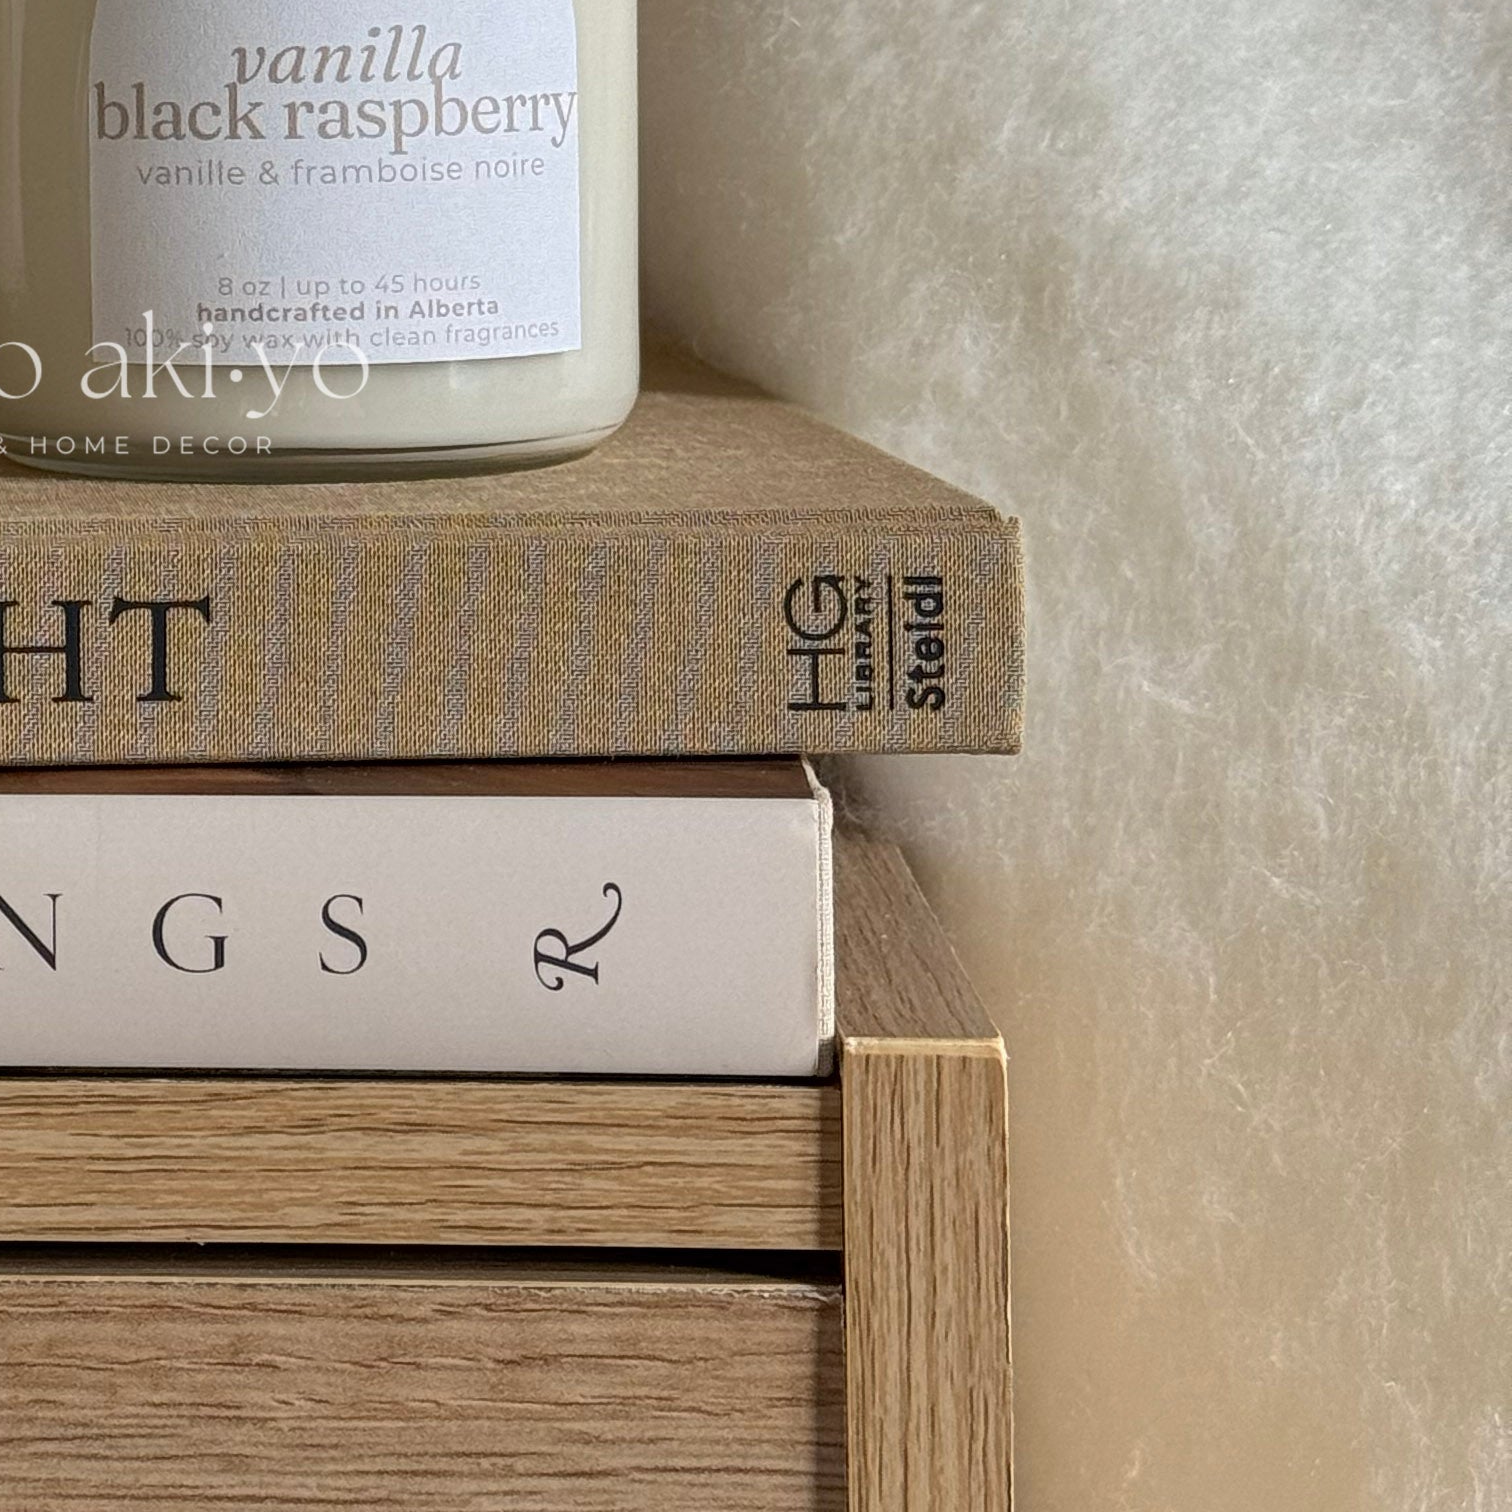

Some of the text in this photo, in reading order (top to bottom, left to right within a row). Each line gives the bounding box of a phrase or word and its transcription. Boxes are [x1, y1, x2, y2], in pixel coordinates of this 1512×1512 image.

[231, 24, 463, 85] vanilla
[94, 79, 578, 154] black raspberry
[136, 153, 545, 186] vanille & framboise noire
[196, 298, 499, 322] handcrafted in Alberta
[218, 277, 232, 296] 8
[242, 280, 270, 296] oz
[296, 278, 330, 299] up
[339, 277, 365, 295] to
[374, 274, 404, 294] 45
[413, 273, 480, 292] hours
[192, 333, 234, 354] soy
[242, 334, 294, 349] wax
[302, 327, 360, 348] with
[369, 326, 436, 347] clean
[445, 320, 559, 347] fragrances
[784, 574, 848, 712] HG
[855, 576, 875, 711] LIBRARY
[903, 575, 947, 711] Steidl
